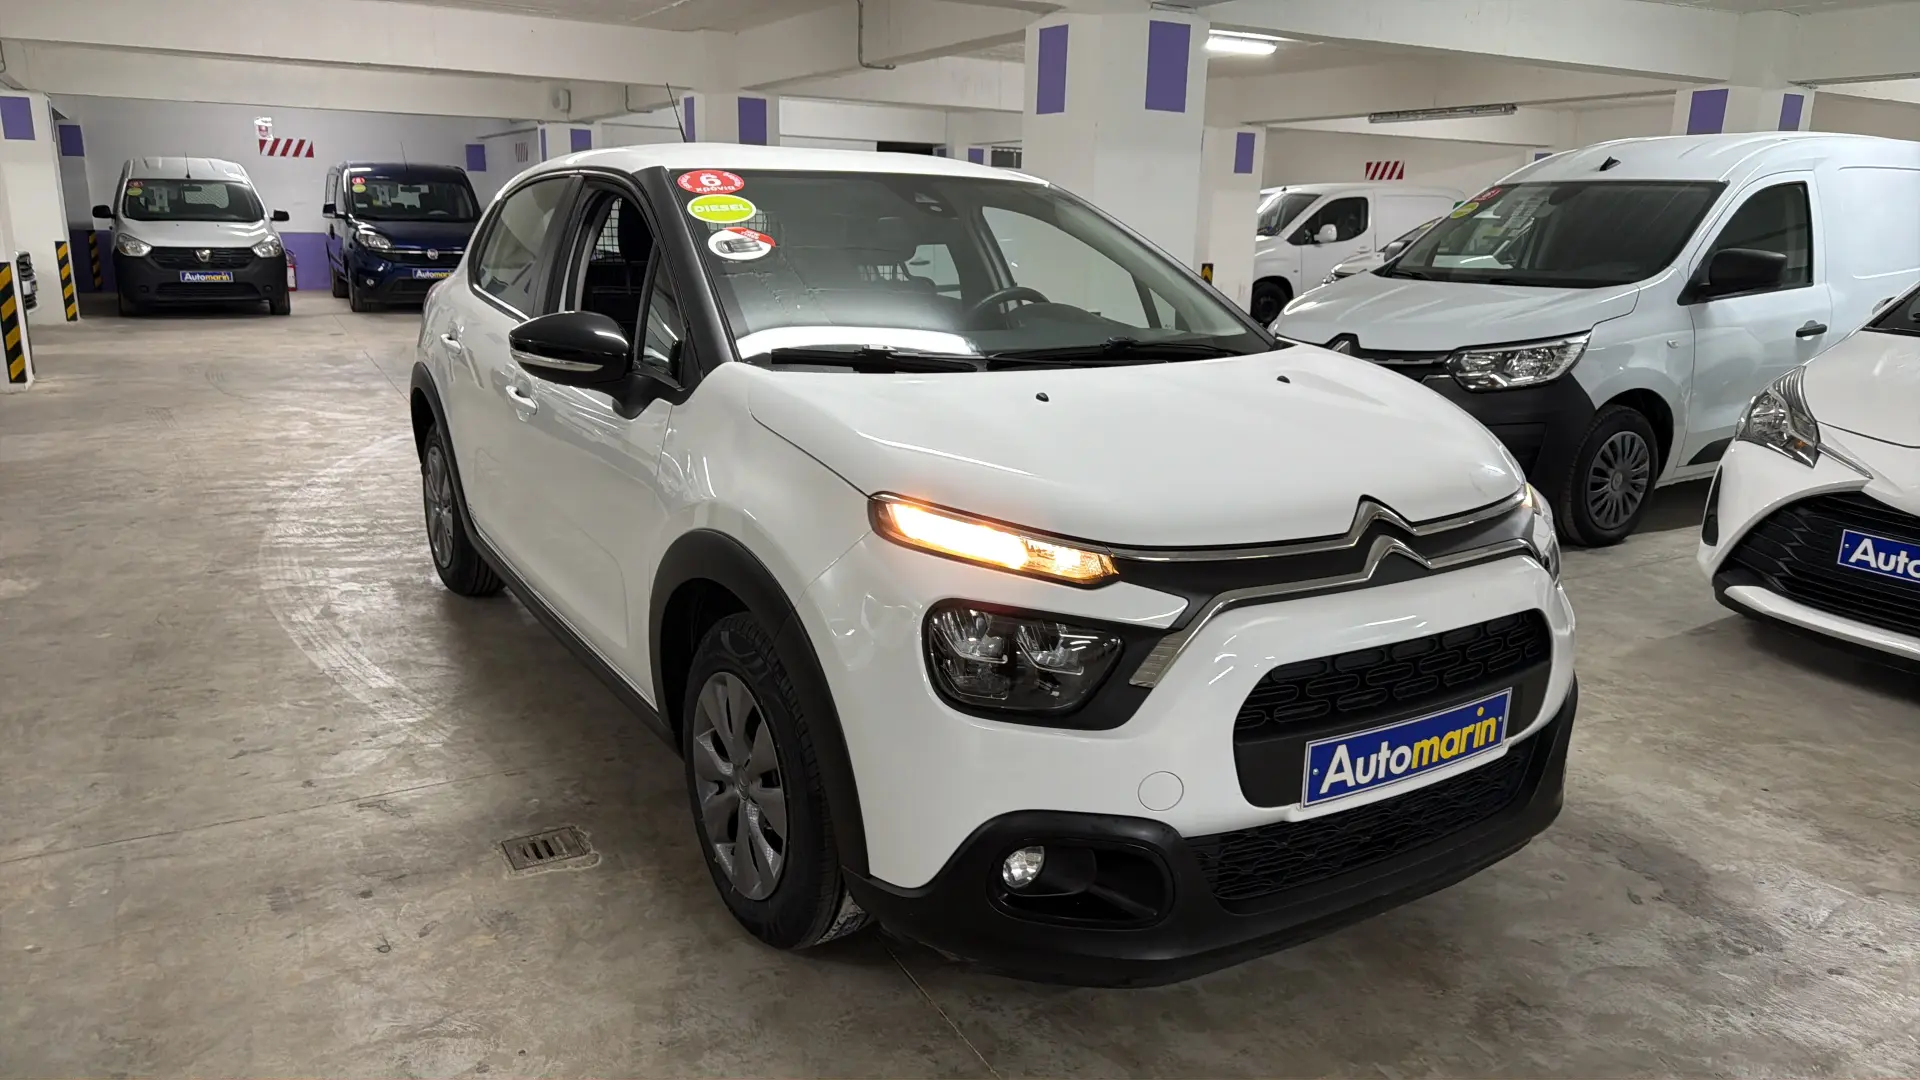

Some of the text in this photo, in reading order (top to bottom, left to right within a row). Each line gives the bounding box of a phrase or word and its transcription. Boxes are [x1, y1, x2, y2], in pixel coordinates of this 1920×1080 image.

[700, 174, 722, 186] 6
[695, 185, 736, 193] χρόνια
[693, 204, 750, 213] DIESEL
[184, 271, 230, 281] Automarin
[1319, 706, 1497, 794] Automarin
